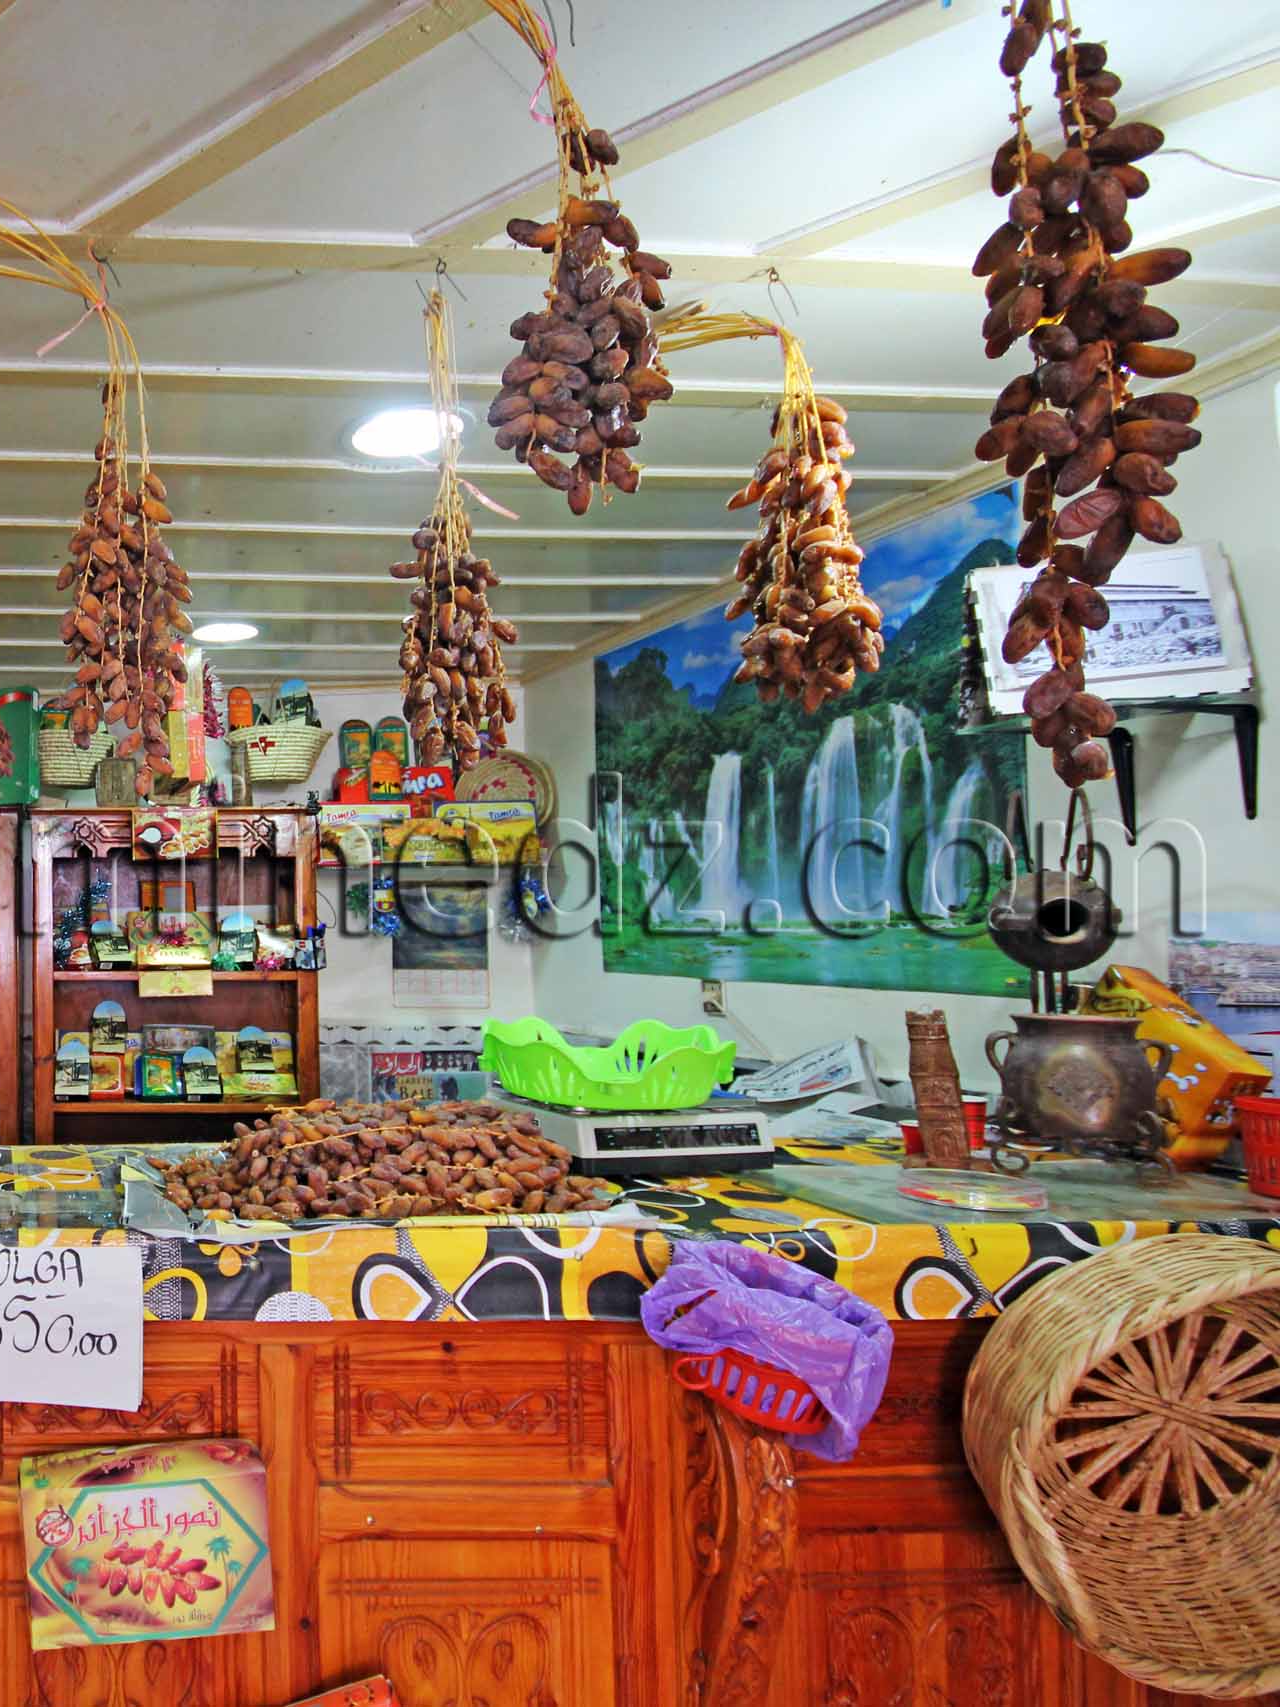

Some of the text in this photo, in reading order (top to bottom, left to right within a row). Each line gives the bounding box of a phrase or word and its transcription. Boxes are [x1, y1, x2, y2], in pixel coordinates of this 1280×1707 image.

[325, 809, 357, 822] Tamra
[489, 808, 521, 822] Tamra
[163, 1500, 221, 1537] تمور
